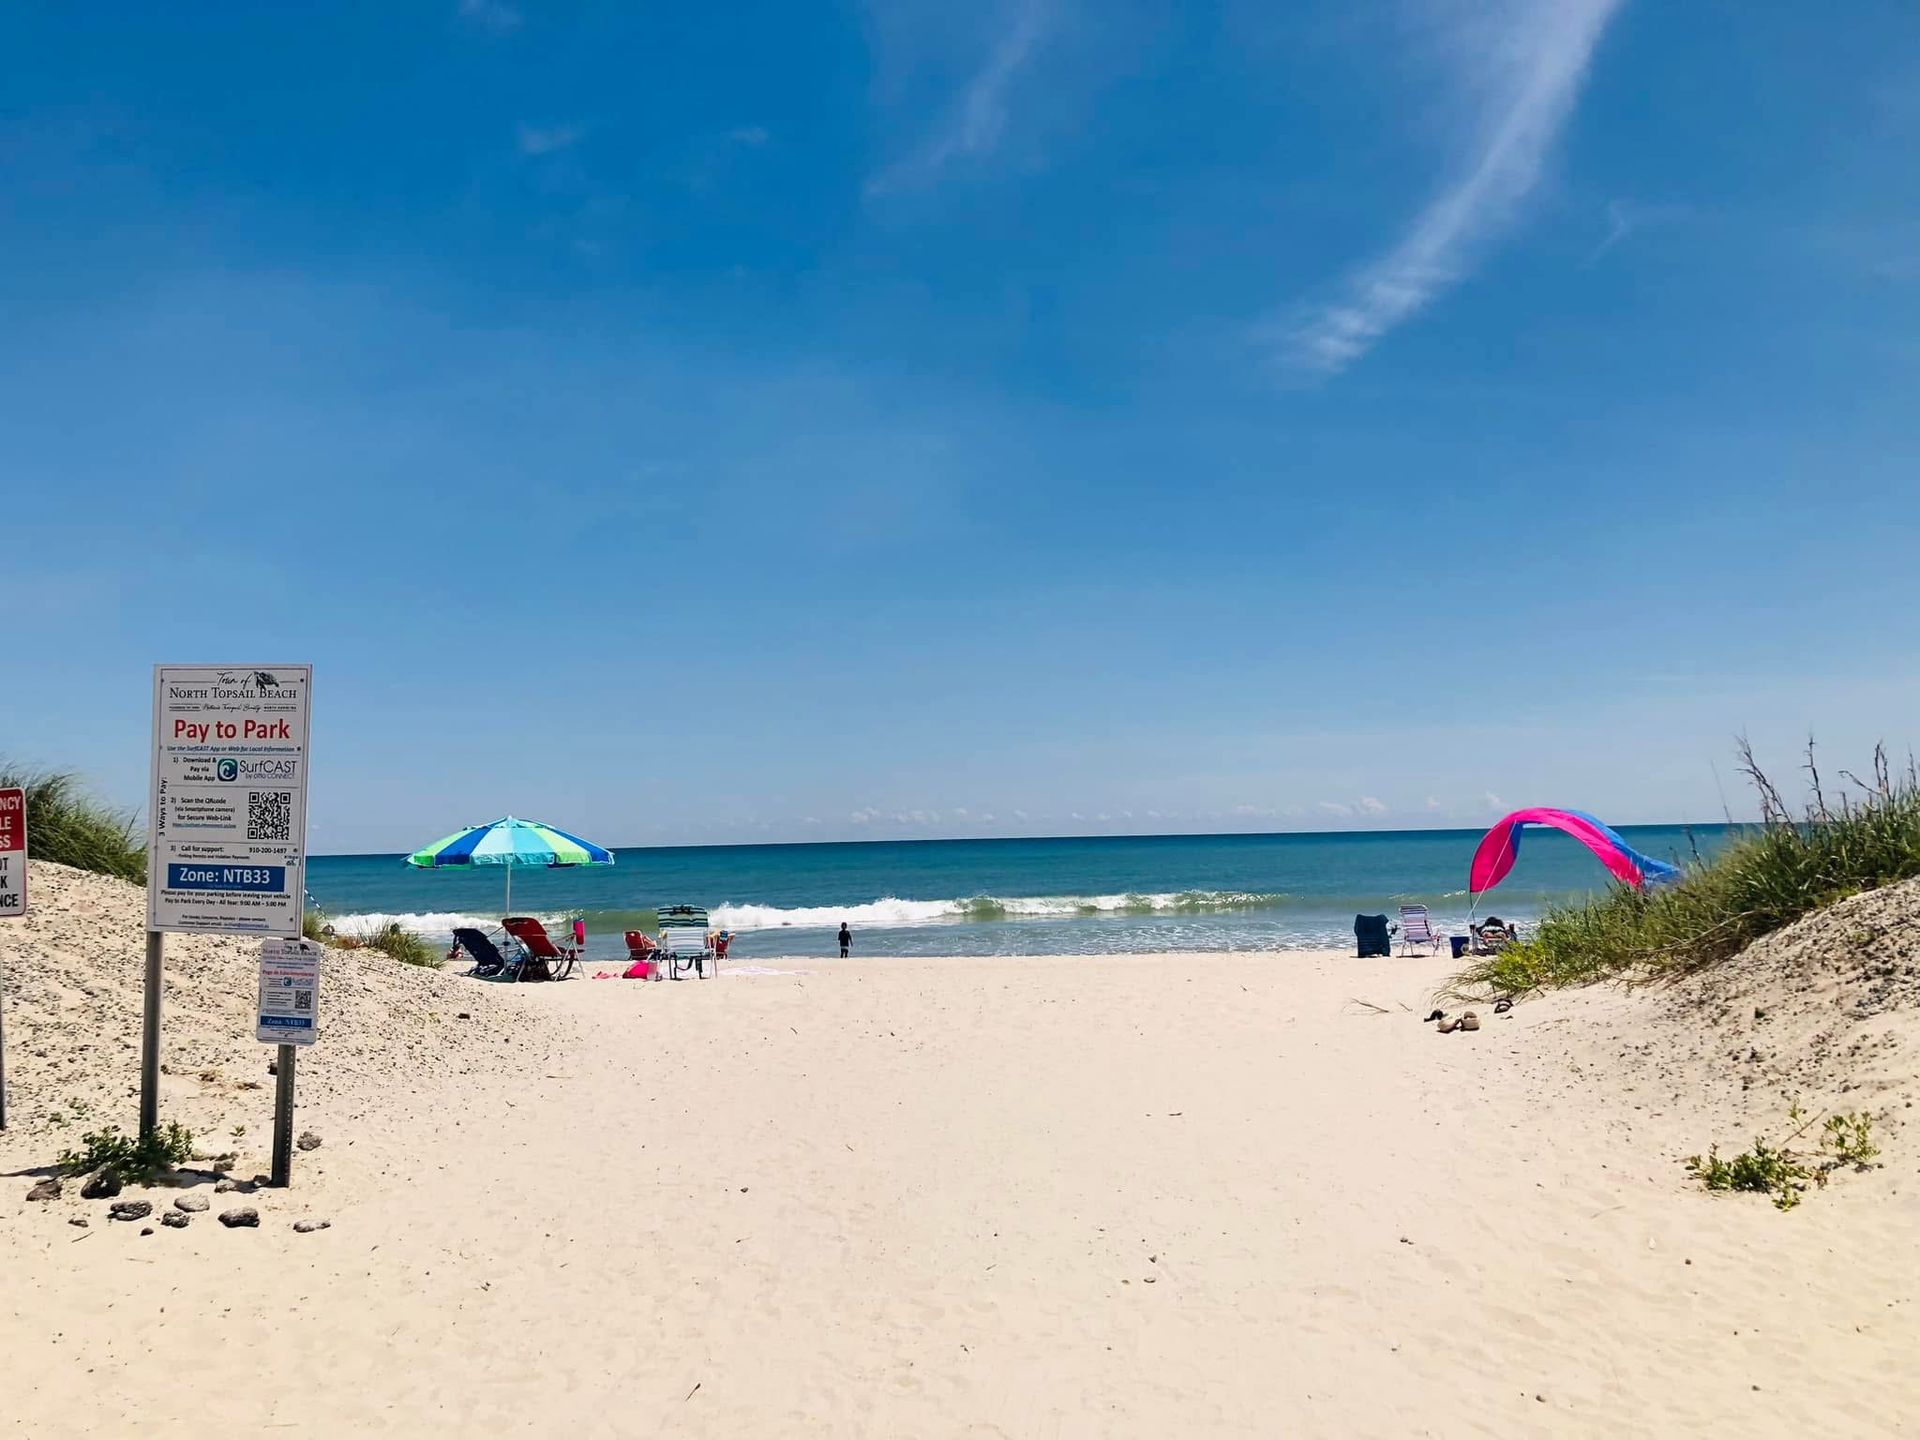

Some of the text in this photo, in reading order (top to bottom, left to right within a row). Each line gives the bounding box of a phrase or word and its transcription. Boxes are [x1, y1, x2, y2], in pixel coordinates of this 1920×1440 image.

[240, 673, 252, 690] of
[174, 718, 290, 743] Pay to Park
[240, 760, 297, 774] SurfCAST
[160, 796, 167, 805] to
[158, 806, 168, 830] Ways
[179, 867, 271, 885] Zone: NTB33
